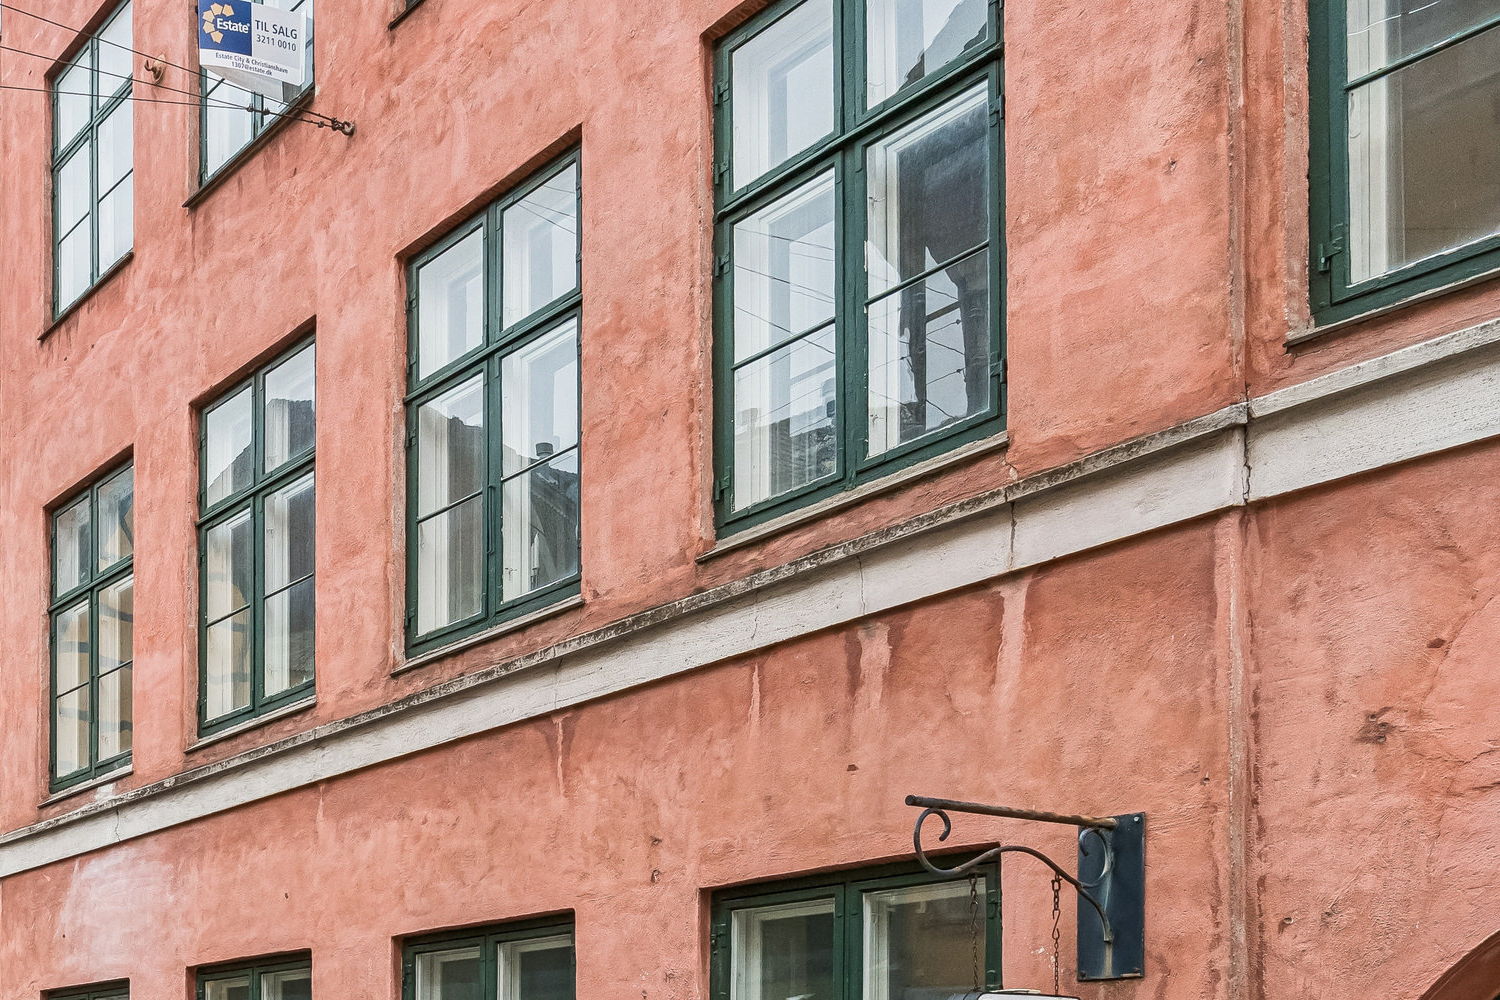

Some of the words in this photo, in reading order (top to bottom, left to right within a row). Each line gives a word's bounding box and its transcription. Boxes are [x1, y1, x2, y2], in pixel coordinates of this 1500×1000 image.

[217, 18, 249, 34] Estate
[255, 20, 269, 33] TIL
[272, 24, 298, 40] SALG
[256, 34, 275, 46] 3211
[277, 40, 297, 52] 0010
[215, 52, 233, 60] Estate
[234, 55, 245, 64] City
[251, 59, 288, 74] Christianshavn
